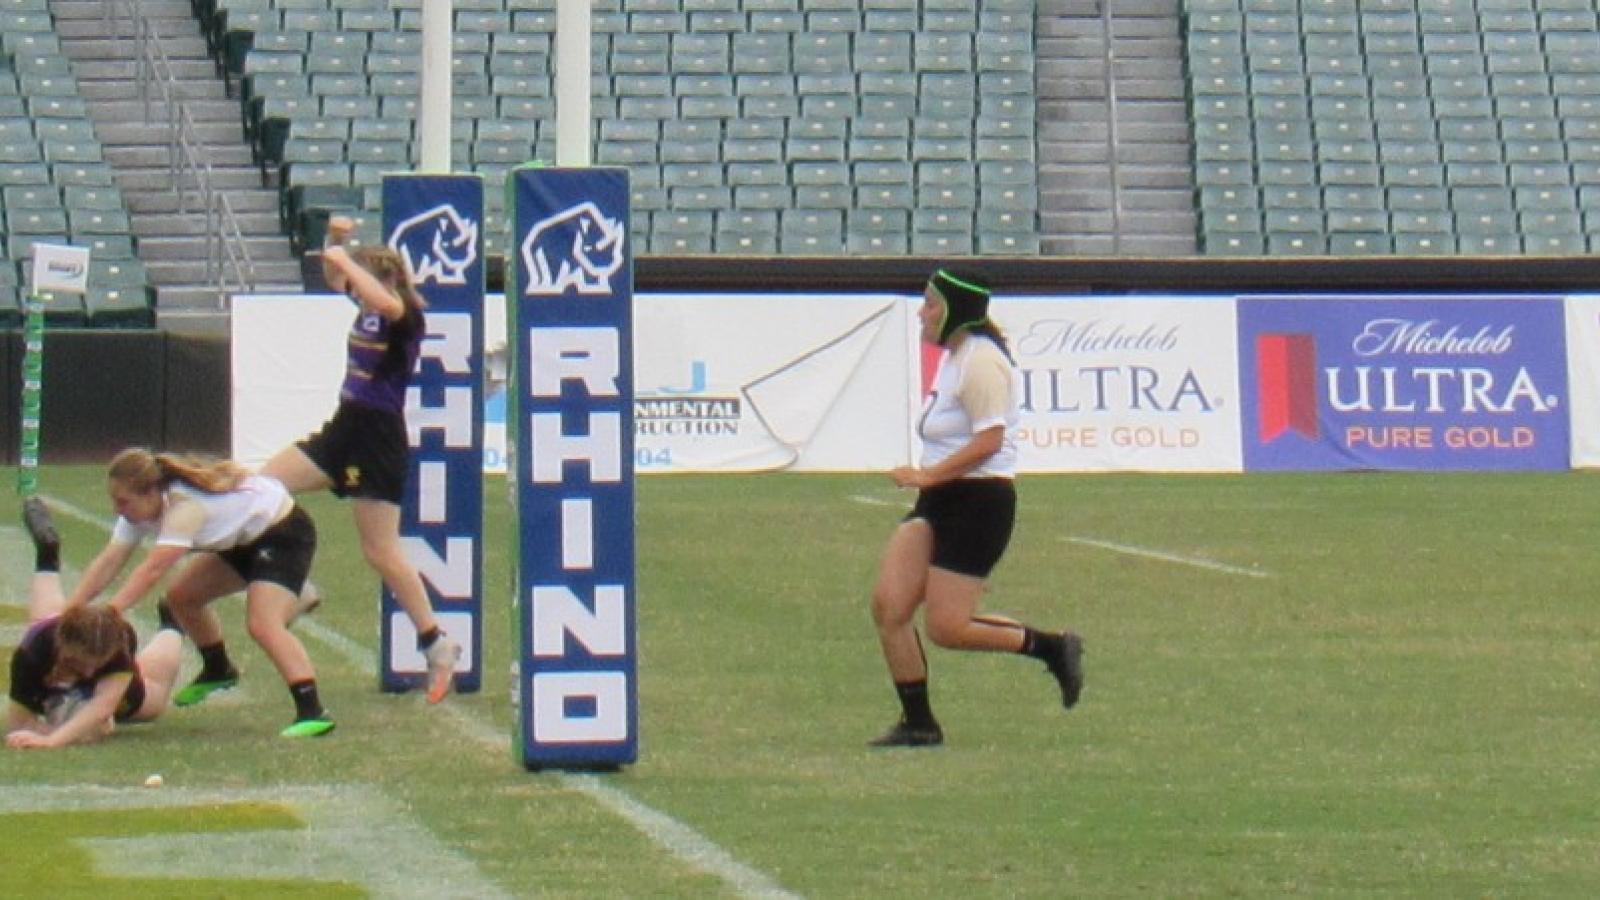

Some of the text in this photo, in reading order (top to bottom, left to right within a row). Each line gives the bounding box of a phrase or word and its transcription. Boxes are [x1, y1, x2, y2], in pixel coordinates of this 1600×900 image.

[1019, 319, 1181, 356] Michelob
[1353, 319, 1516, 356] Michelob
[1111, 427, 1200, 448] GOLD
[1345, 426, 1534, 448] PURE GOLD
[530, 327, 627, 742] RHINO
